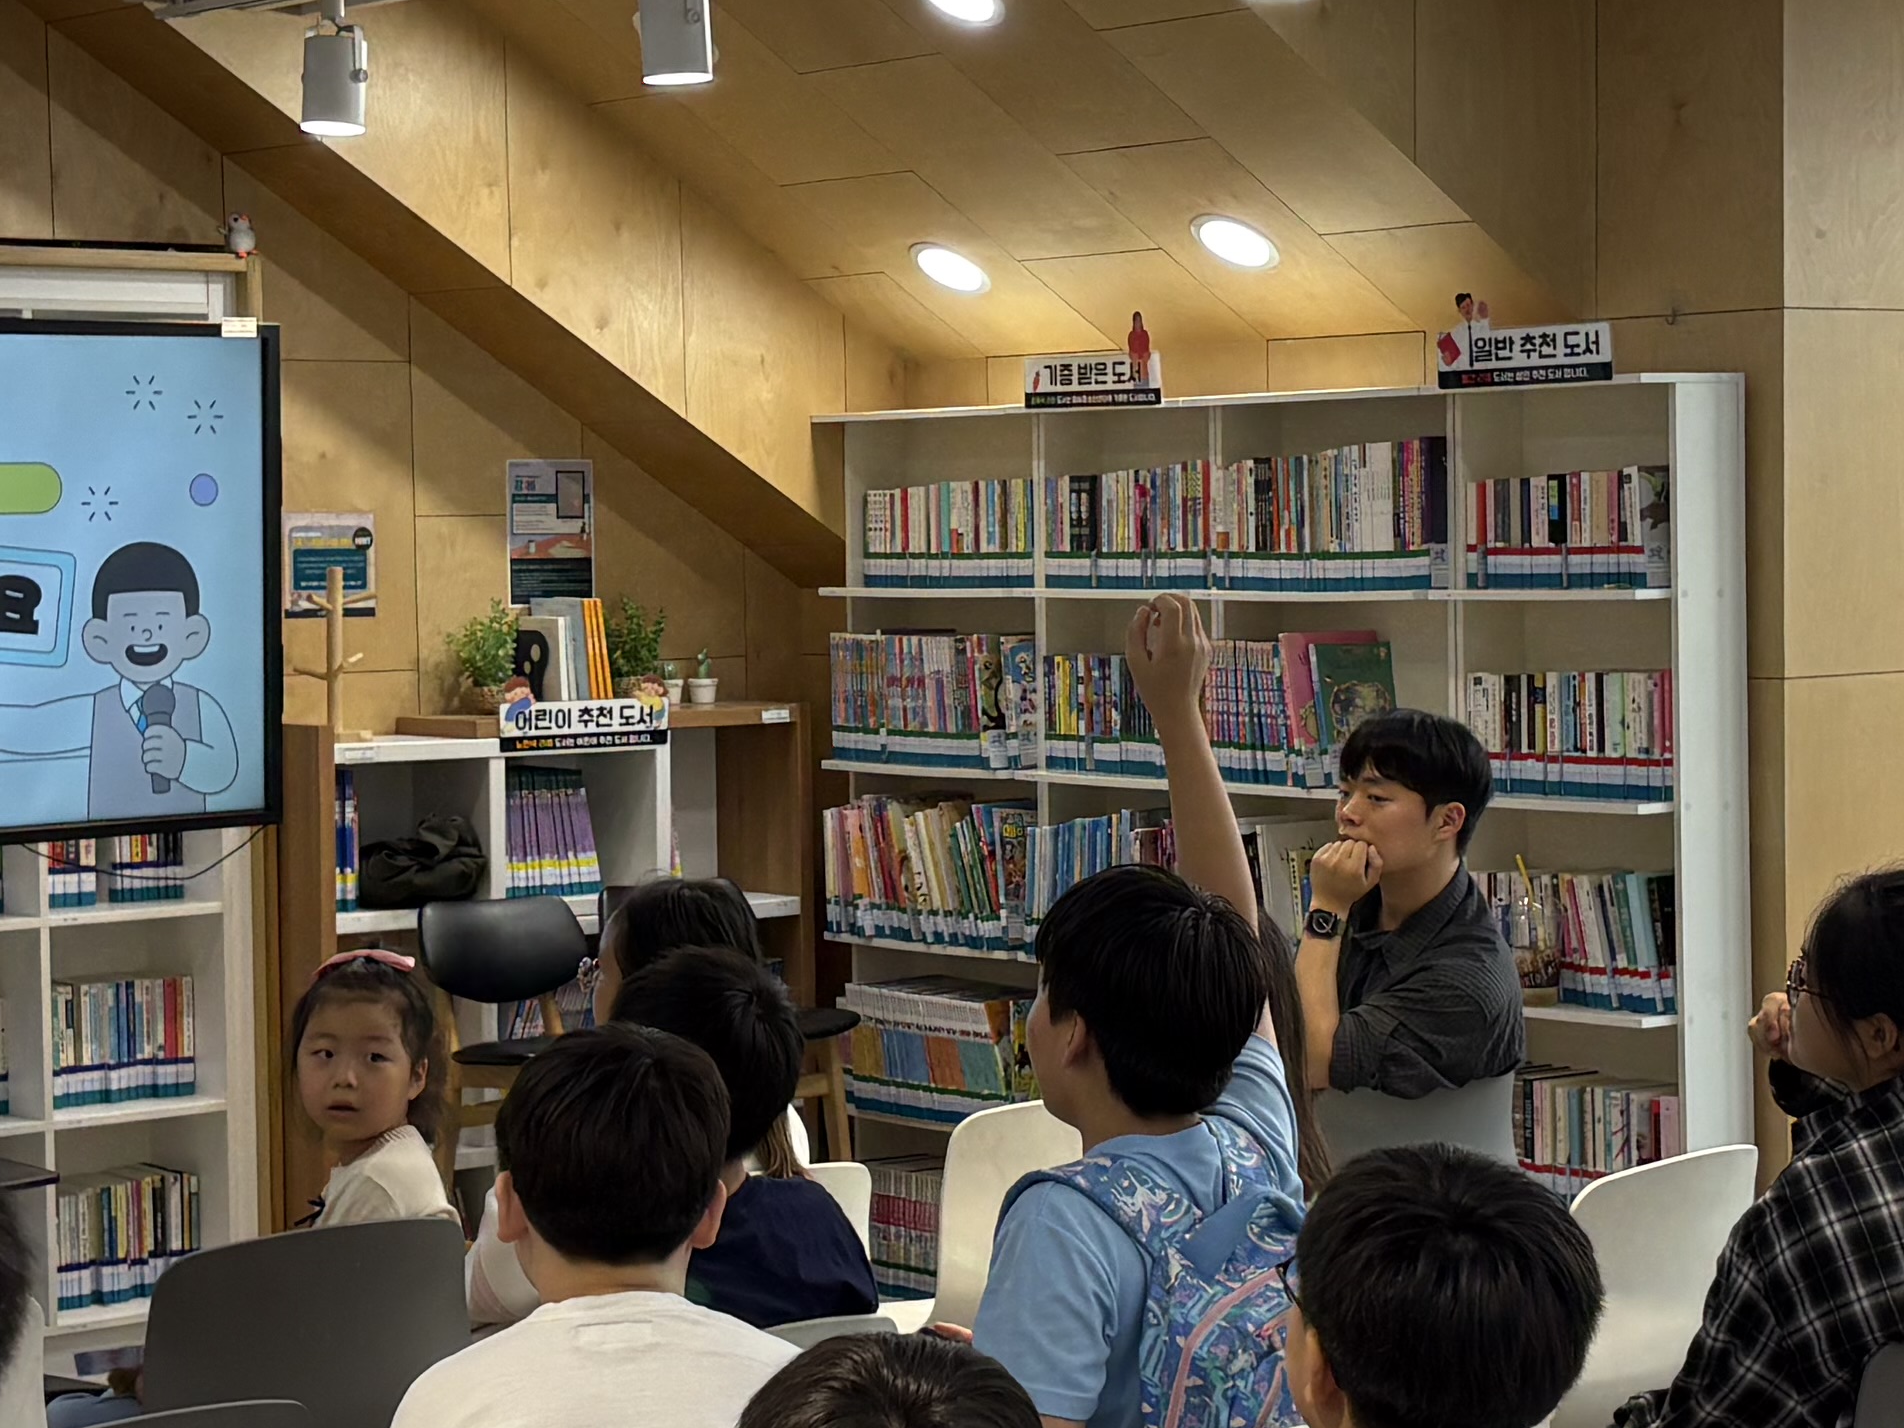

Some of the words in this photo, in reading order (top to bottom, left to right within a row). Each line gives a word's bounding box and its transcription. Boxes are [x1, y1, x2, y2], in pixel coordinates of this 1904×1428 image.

[1473, 335, 1515, 363] 일반
[1519, 332, 1558, 360] 추천
[1563, 329, 1601, 357] 도서
[1043, 363, 1074, 387] 기증
[1077, 361, 1108, 386] 받은
[1111, 360, 1142, 385] 도서
[514, 707, 573, 732] 어린이
[577, 705, 614, 729] 추천
[619, 704, 655, 728] 도서
